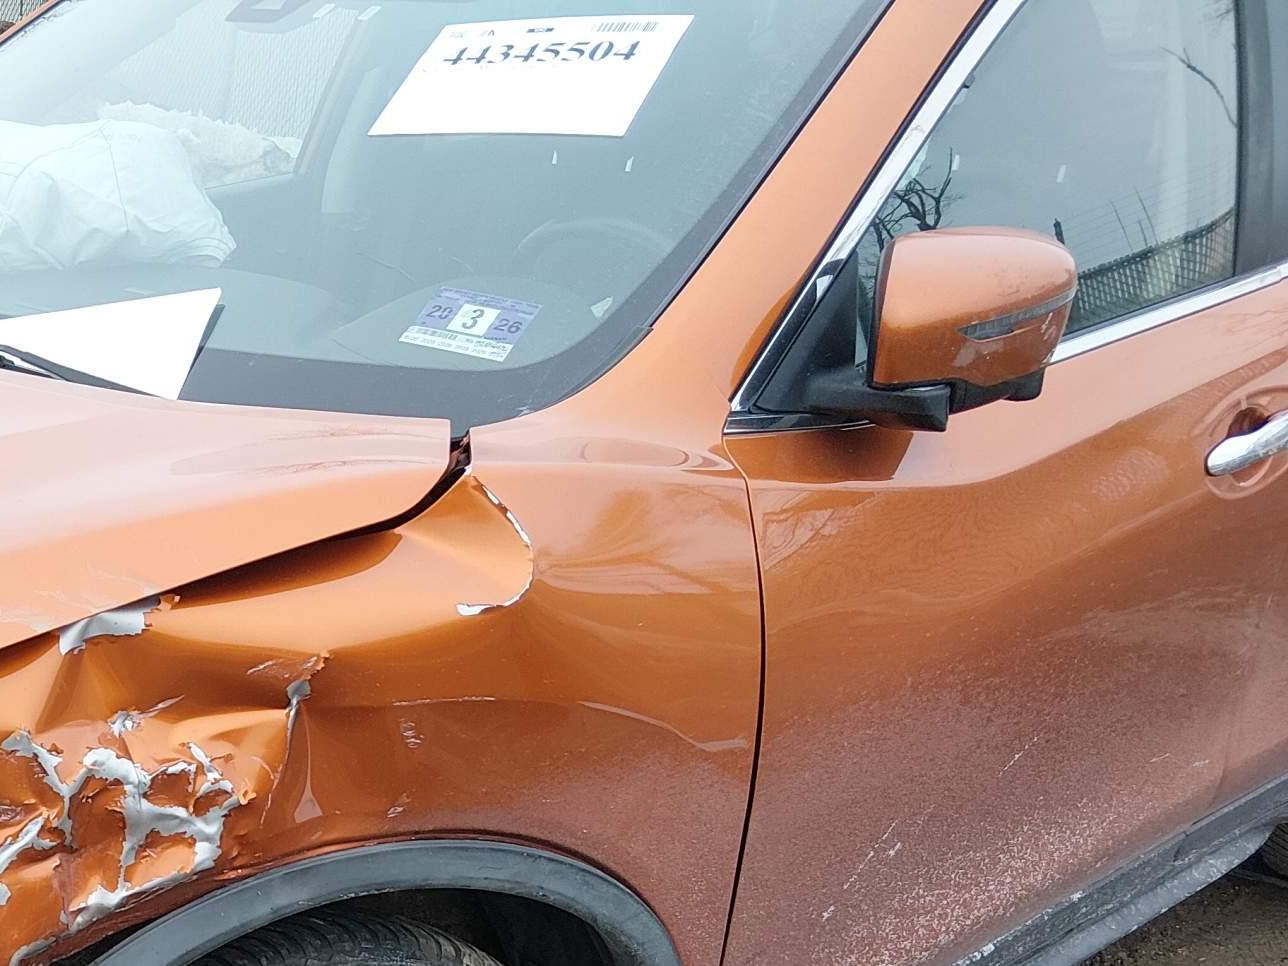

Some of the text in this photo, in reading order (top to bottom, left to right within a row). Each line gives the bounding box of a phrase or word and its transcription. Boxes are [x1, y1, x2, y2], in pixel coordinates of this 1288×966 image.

[443, 40, 641, 65] 44345504
[426, 304, 523, 334] 20 3 26
